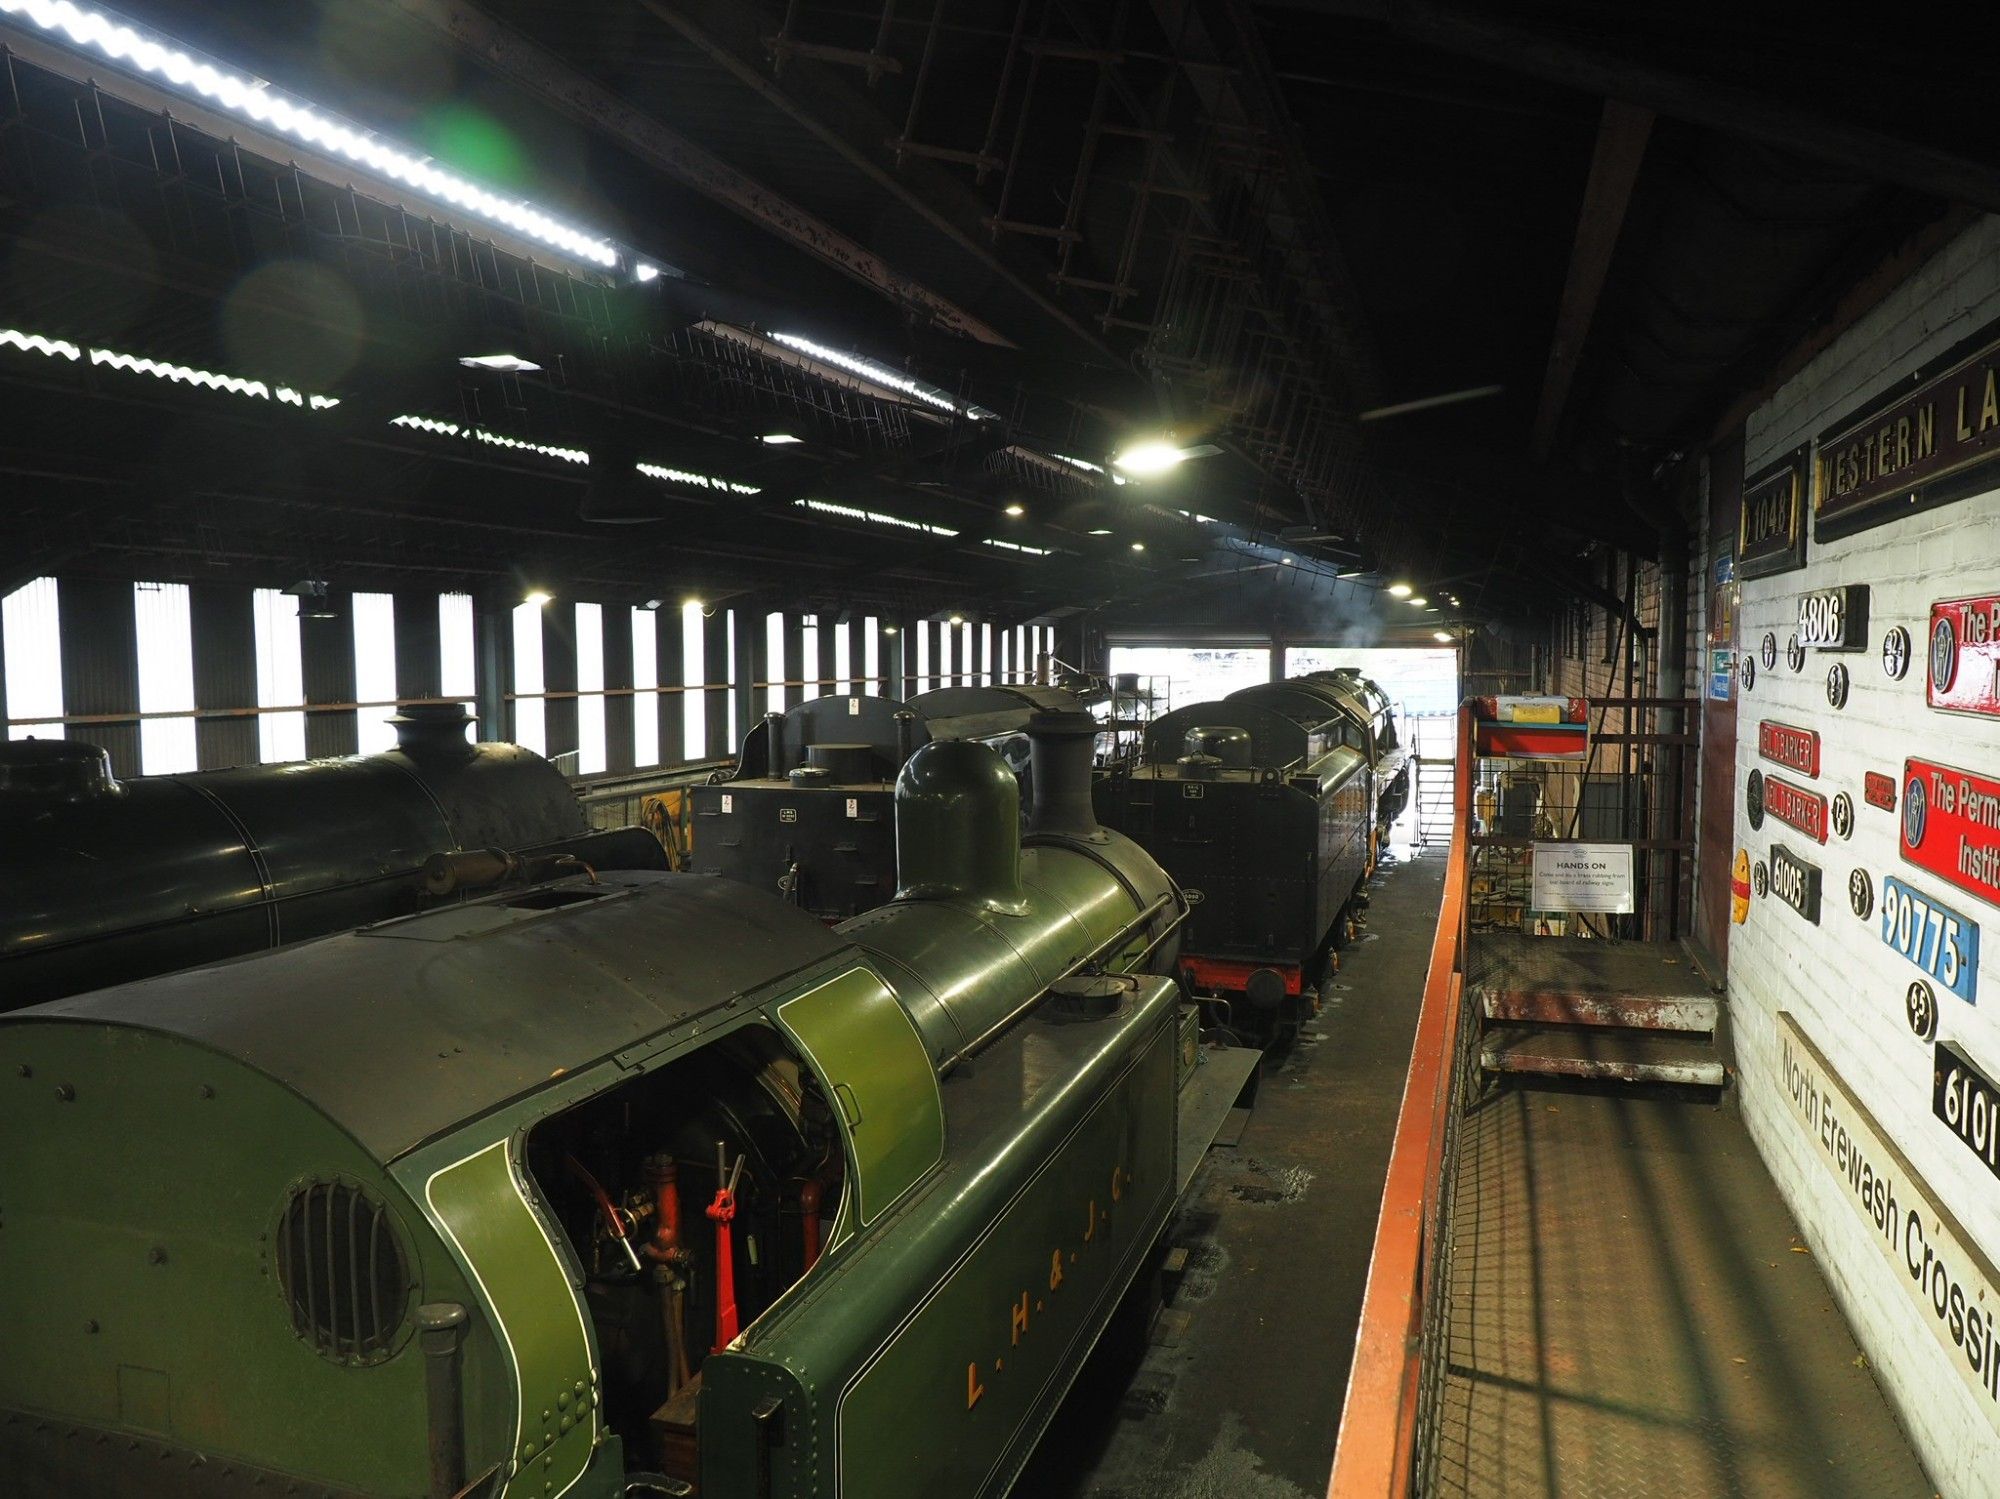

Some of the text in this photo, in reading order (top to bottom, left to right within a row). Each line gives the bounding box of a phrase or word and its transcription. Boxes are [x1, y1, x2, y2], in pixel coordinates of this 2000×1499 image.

[1823, 368, 2000, 500] WESTERN LA
[1799, 595, 1839, 641] 4806
[1960, 604, 1986, 643] The
[1930, 771, 1956, 814] The
[1958, 778, 2000, 830] Perm
[1556, 862, 1589, 870] HANDS
[1774, 856, 1802, 908] 61005
[1853, 872, 1862, 895] 55
[1853, 895, 1859, 914] A
[1886, 885, 1958, 989] 90775
[1911, 985, 1926, 1016] 65
[1913, 1011, 1920, 1033] F
[1945, 1068, 1997, 1166] 6101
[1782, 1038, 1818, 1131] North
[1821, 1091, 1899, 1252] Erewash
[1011, 1290, 1044, 1347] H.
